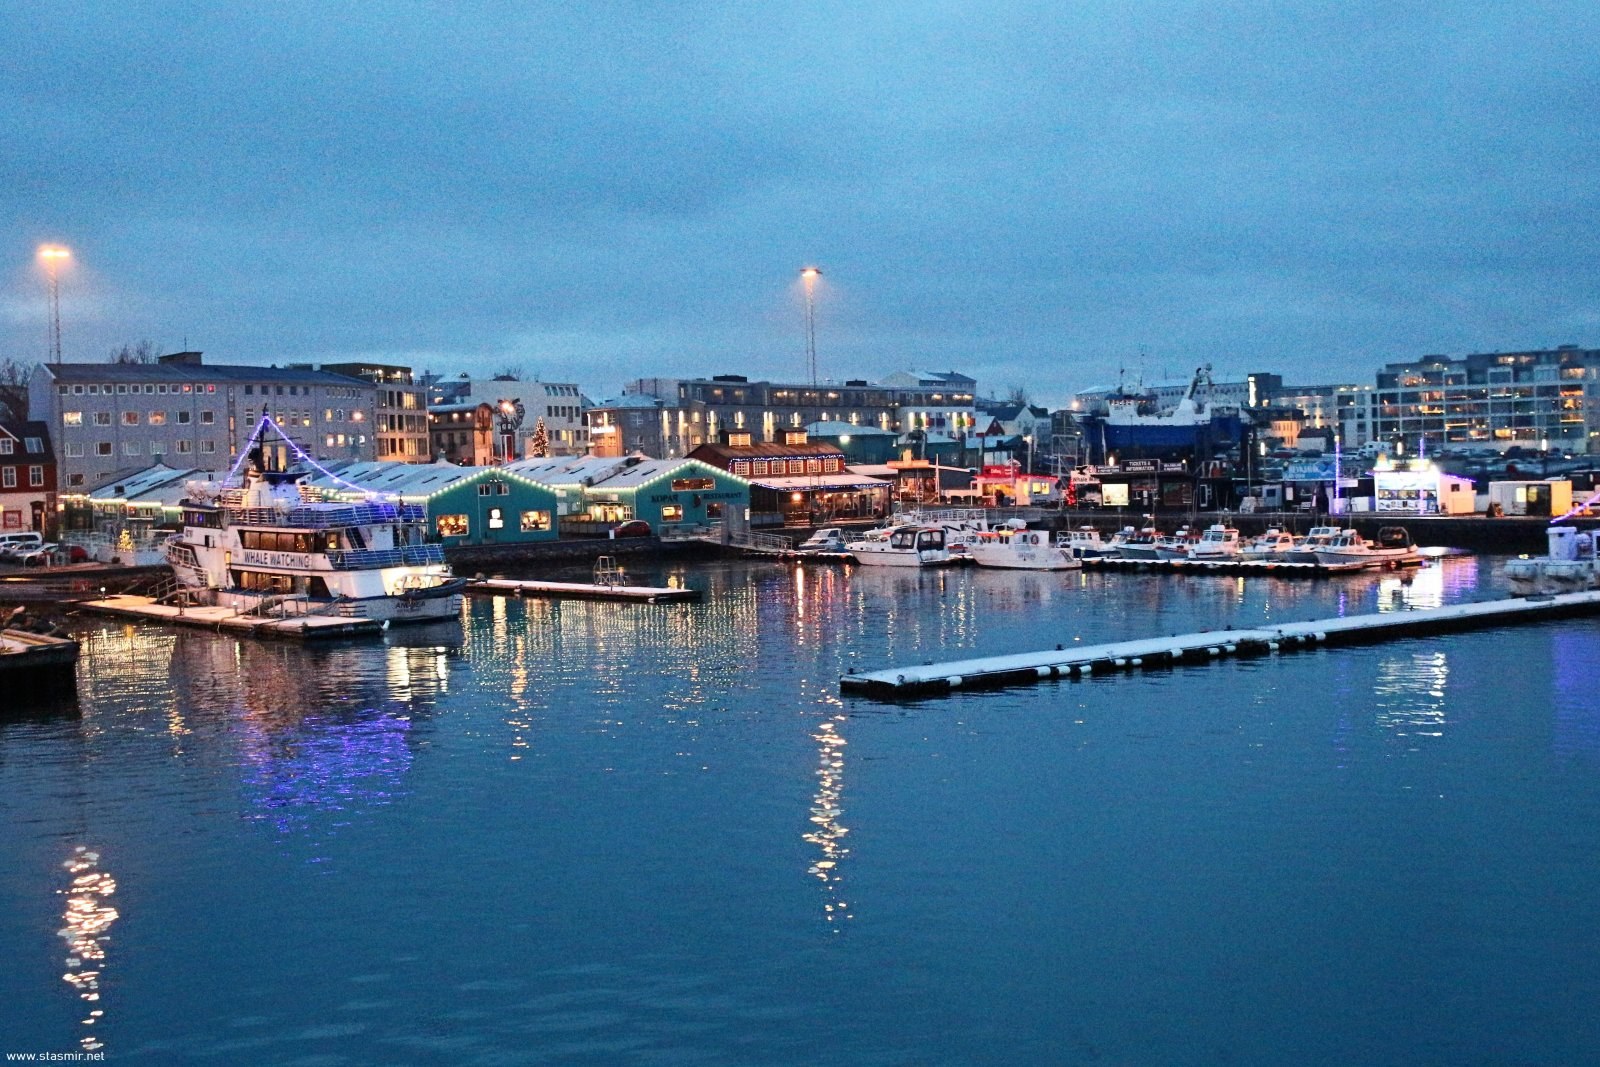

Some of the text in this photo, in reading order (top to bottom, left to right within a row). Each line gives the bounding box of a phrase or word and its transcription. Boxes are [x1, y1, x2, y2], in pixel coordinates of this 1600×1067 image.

[703, 492, 742, 500] RESTAURANT
[244, 550, 310, 568] WHALE WATCHING
